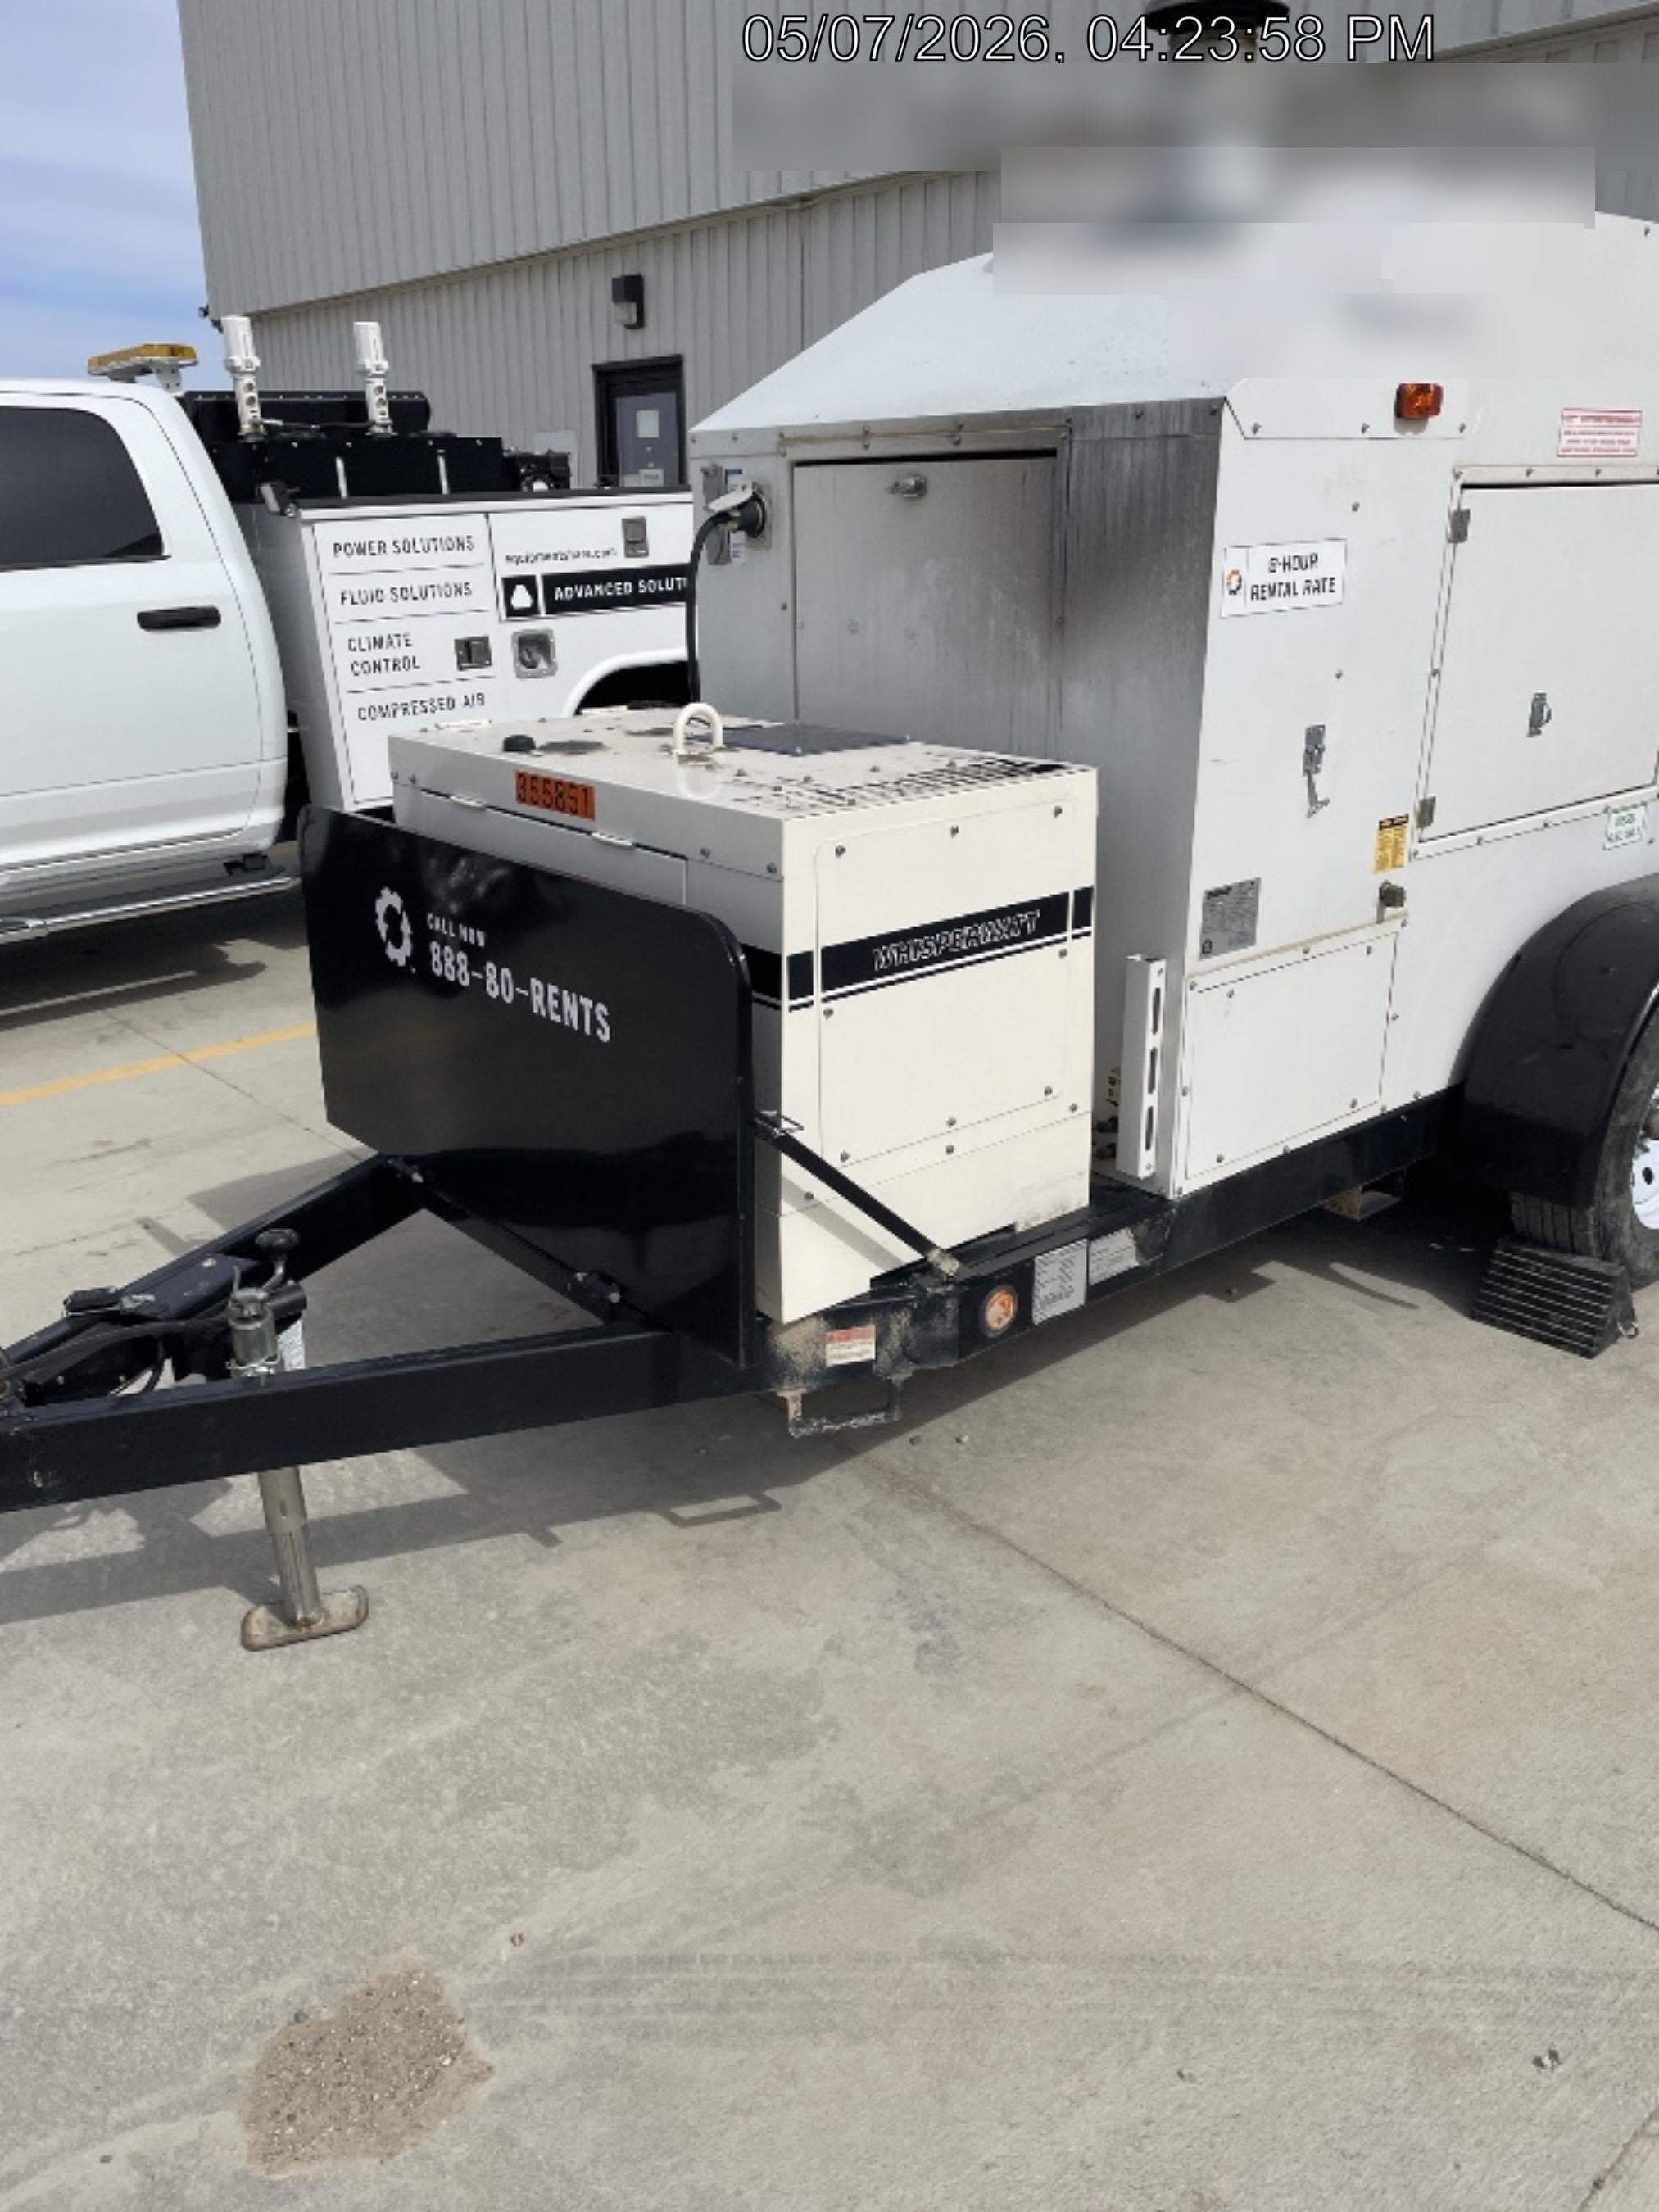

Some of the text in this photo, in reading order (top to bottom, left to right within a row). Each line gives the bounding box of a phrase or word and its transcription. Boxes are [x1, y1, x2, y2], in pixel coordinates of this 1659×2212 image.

[332, 535, 475, 558] POWER SOLUTIONS
[340, 582, 473, 605] FLUID SOLUTIONS
[554, 581, 633, 601] ADVANCED
[1250, 577, 1337, 601] RENTAL RATE
[347, 632, 413, 652] CLIMATE
[350, 655, 421, 677] CONTROL
[358, 692, 486, 721] COMPRESSED AIR
[515, 771, 589, 814] 355851
[427, 913, 487, 947] CALL NOW
[429, 940, 611, 1044] 888-80-RENTS
